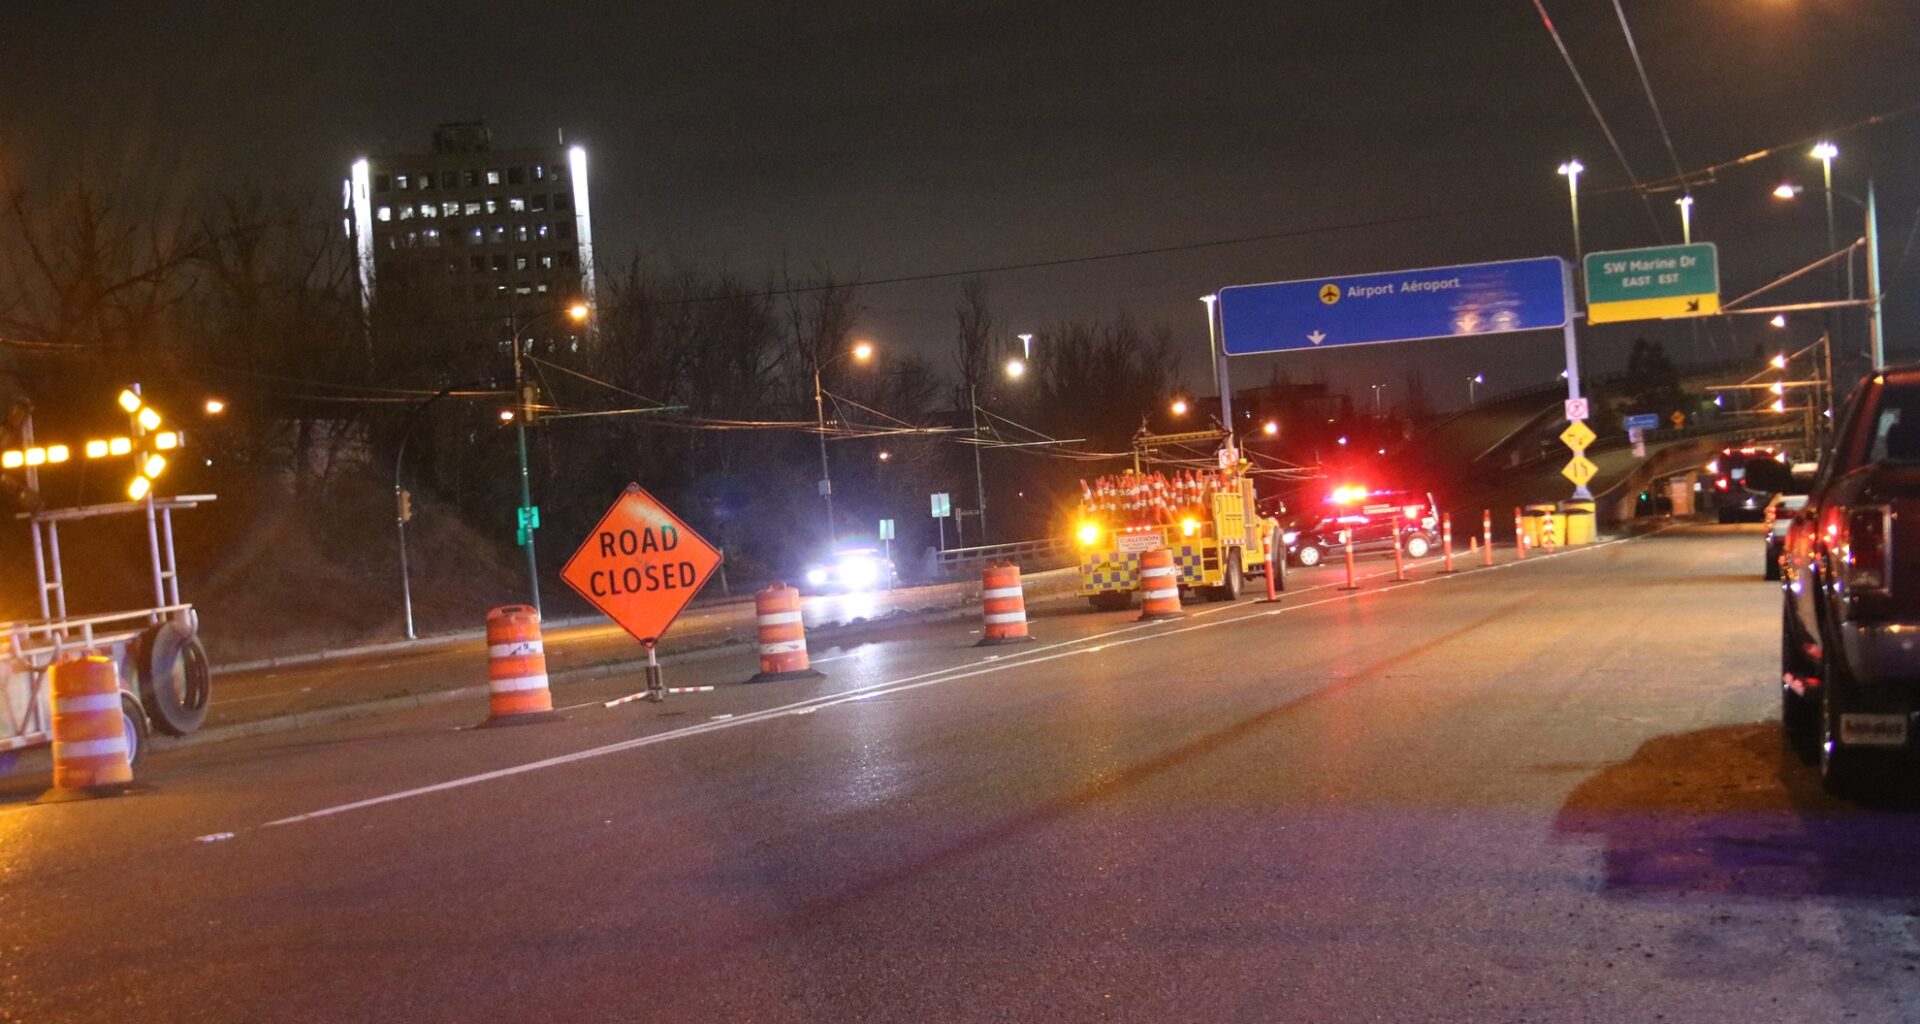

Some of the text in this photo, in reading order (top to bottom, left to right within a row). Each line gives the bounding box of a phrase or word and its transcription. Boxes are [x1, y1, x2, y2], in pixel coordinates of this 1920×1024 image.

[1603, 255, 1697, 274] SW Marine Dr
[1347, 277, 1461, 299] Airport Aéroport
[1622, 272, 1680, 288] EAST EST
[599, 524, 679, 558] ROAD
[1119, 535, 1159, 544] CAUTION
[589, 561, 697, 598] CLOSED
